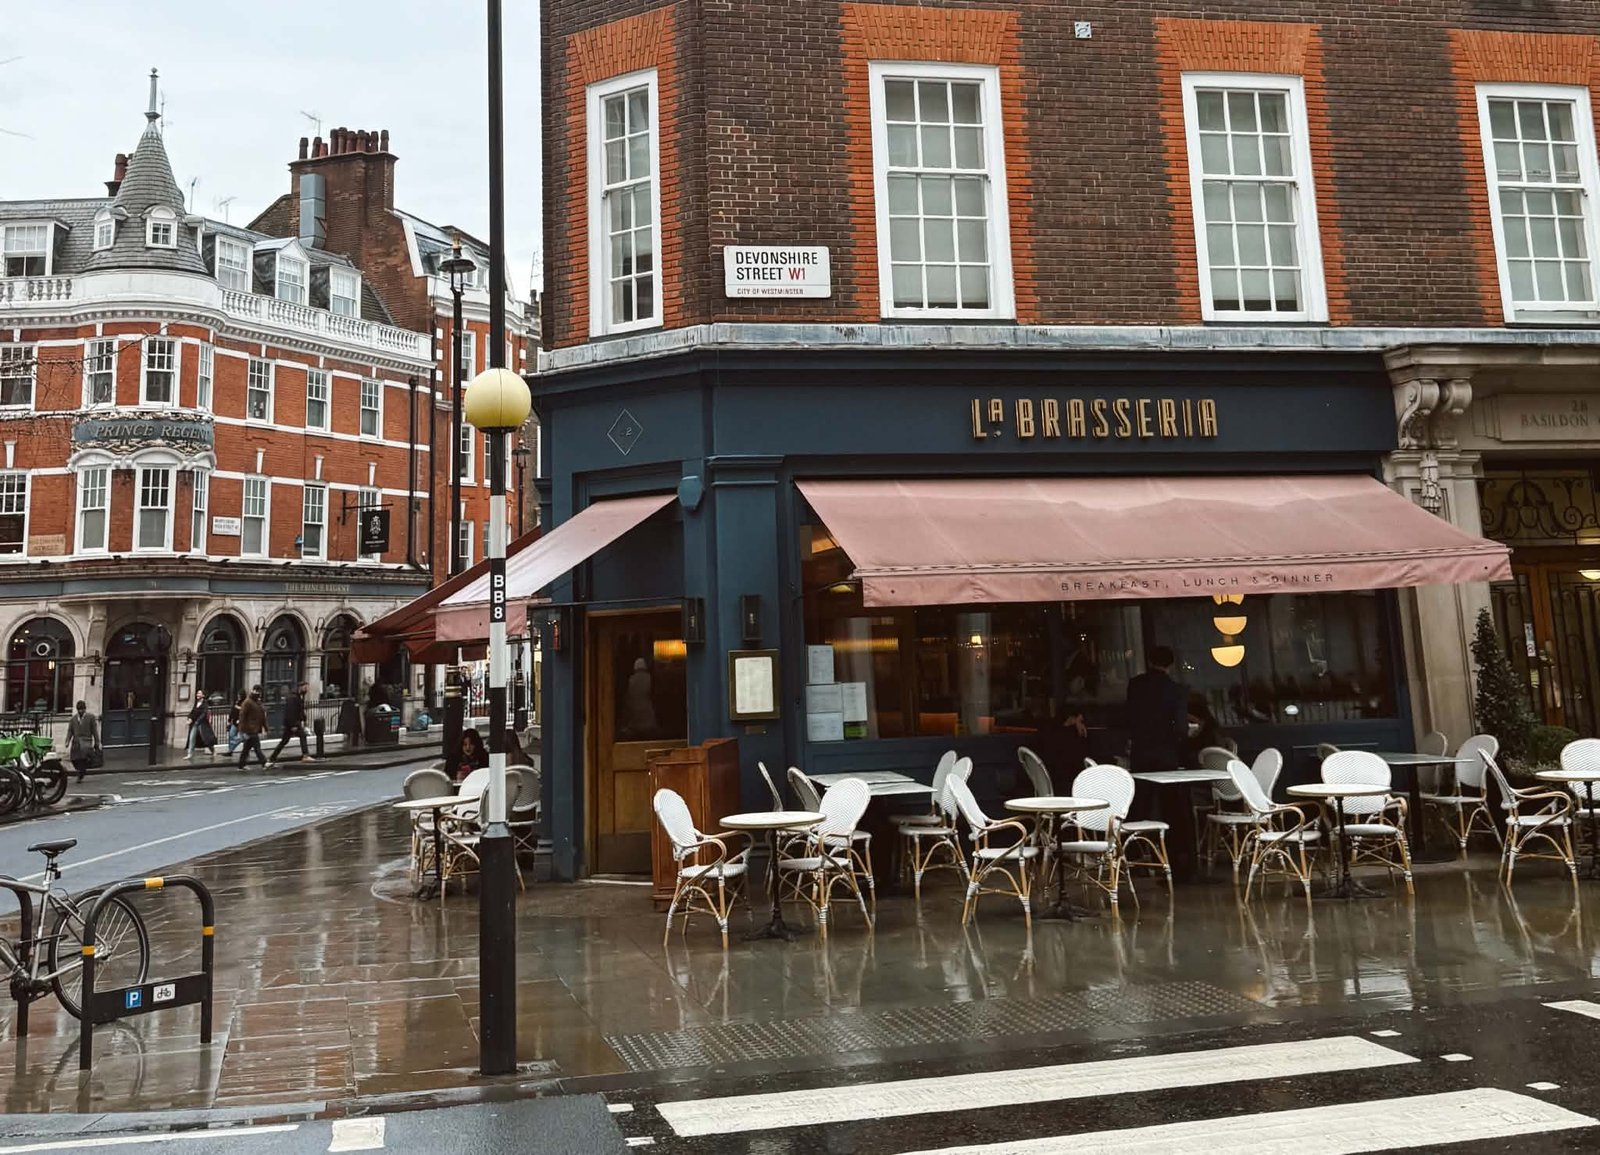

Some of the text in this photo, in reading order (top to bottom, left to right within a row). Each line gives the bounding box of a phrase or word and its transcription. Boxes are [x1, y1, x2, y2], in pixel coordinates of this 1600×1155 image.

[735, 251, 819, 265] DEVONSHIRE
[736, 267, 806, 280] STREET W1
[1015, 398, 1219, 438] BRASSERIA
[1521, 413, 1589, 427] BASILDON
[94, 424, 210, 441] PRINCE REGENT
[1183, 577, 1239, 587] LUNCH
[1271, 573, 1335, 584] DINNER
[494, 574, 504, 619] BB8
[130, 991, 139, 1006] P
